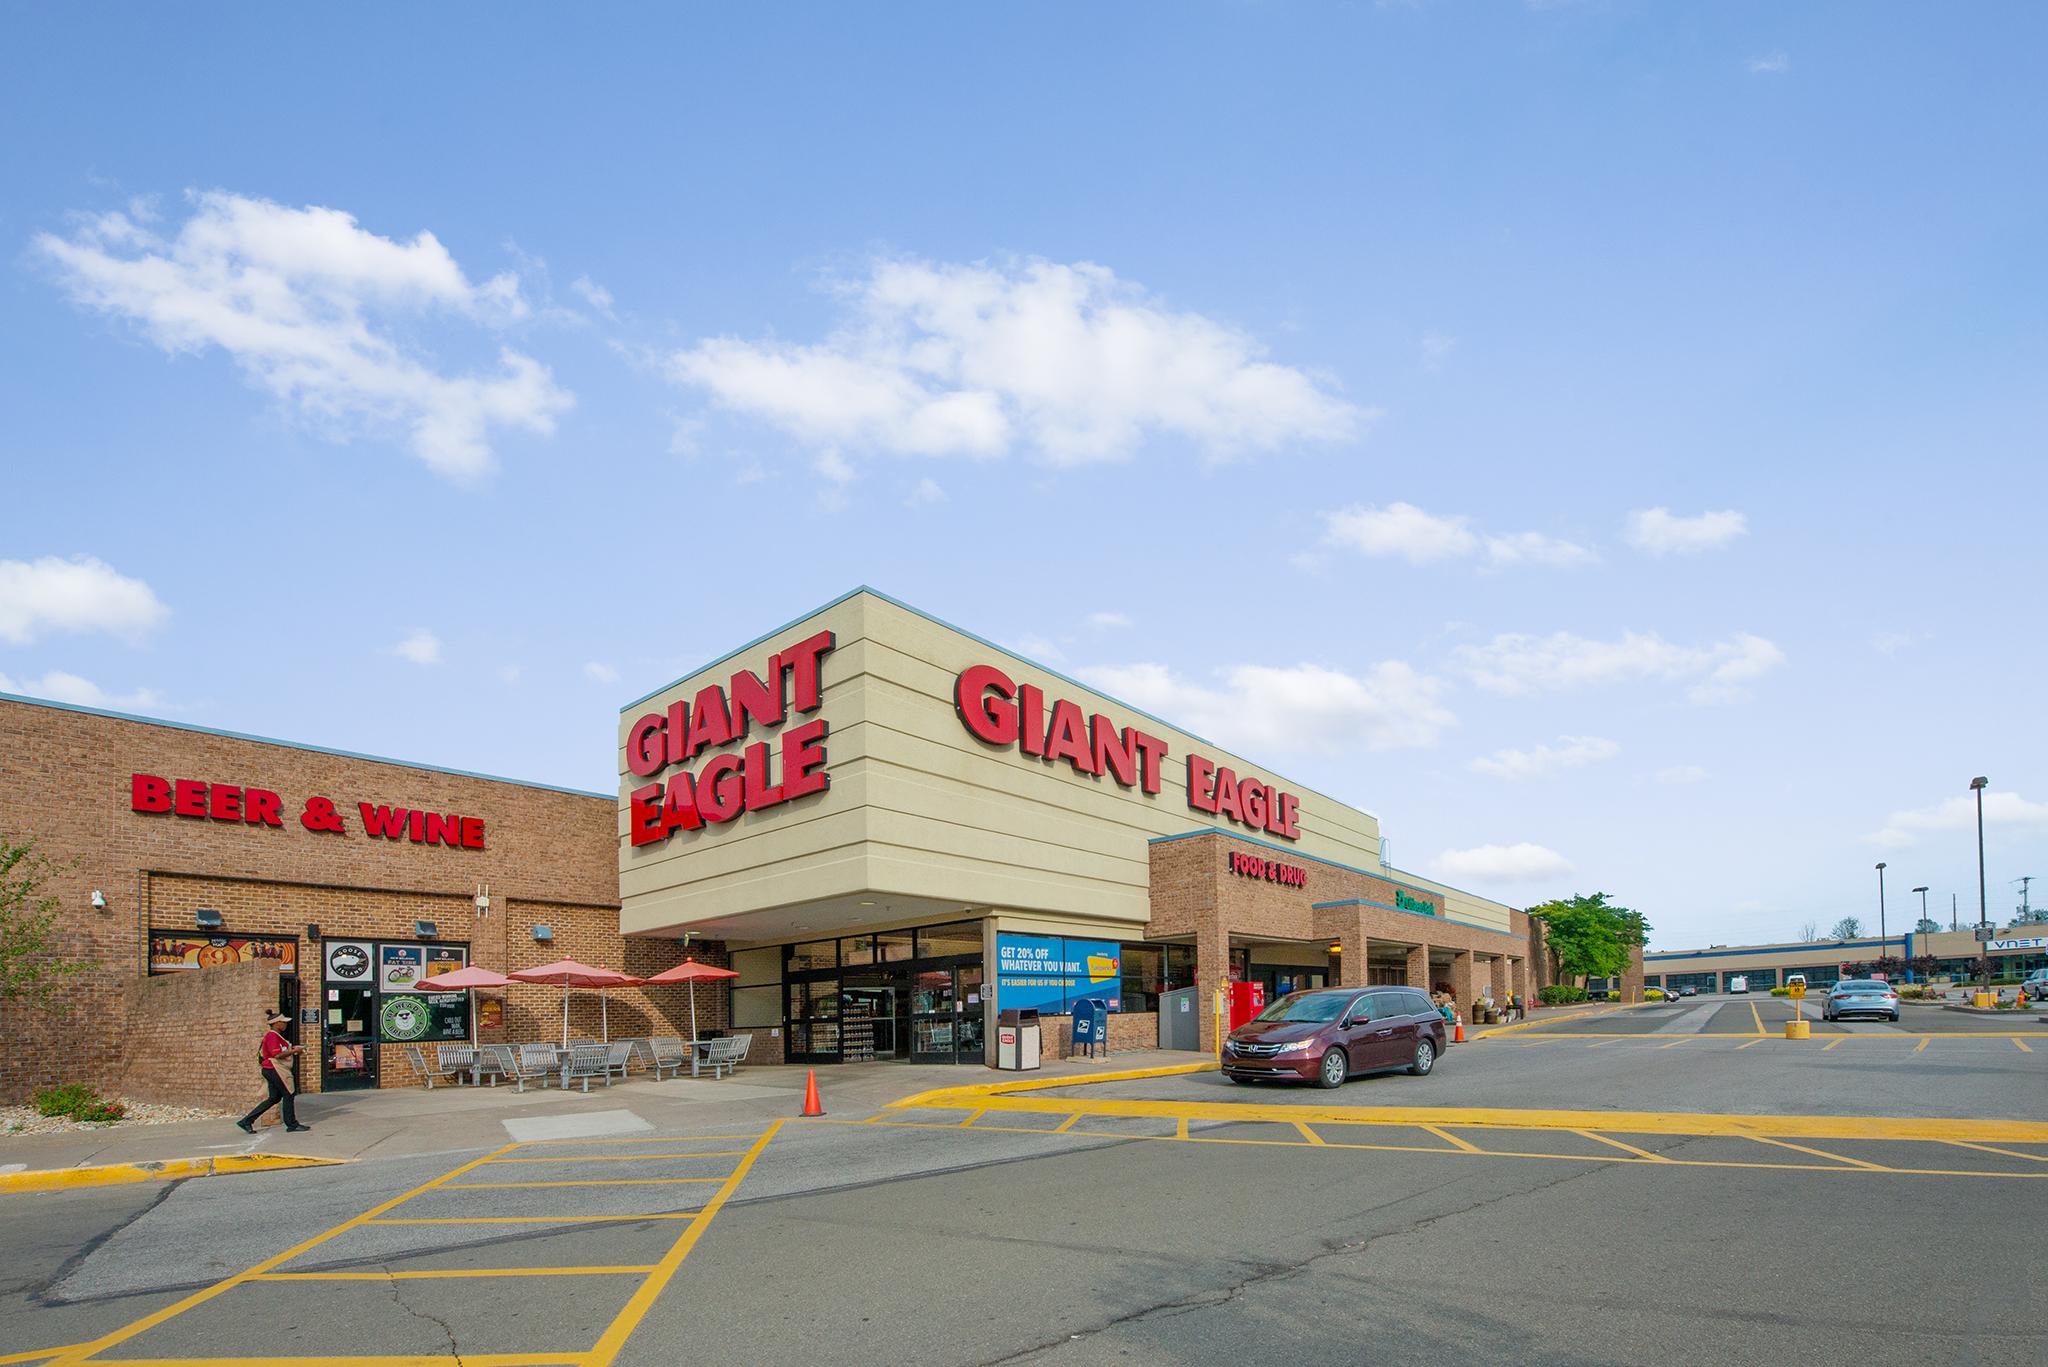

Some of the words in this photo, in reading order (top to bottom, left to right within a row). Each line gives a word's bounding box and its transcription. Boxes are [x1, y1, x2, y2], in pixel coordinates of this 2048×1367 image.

[626, 630, 836, 777] GIANT
[954, 665, 1169, 795] GIANT
[1187, 753, 1300, 841] EAGLE
[631, 719, 830, 847] EAGLE
[132, 773, 284, 827] BEER
[301, 796, 346, 833] &
[358, 802, 485, 849] WINE
[1229, 851, 1266, 878] FOOD
[1266, 861, 1278, 881] &
[1277, 863, 1307, 888] DRUG
[338, 948, 363, 956] GOOSE
[1001, 947, 1016, 958] GET
[1017, 948, 1033, 959] 20%
[1035, 948, 1049, 960] OFF
[1001, 959, 1042, 971] WHATEVER
[1043, 961, 1058, 972] YOU
[1060, 961, 1082, 973] WANT.
[337, 967, 363, 976] ISLAND
